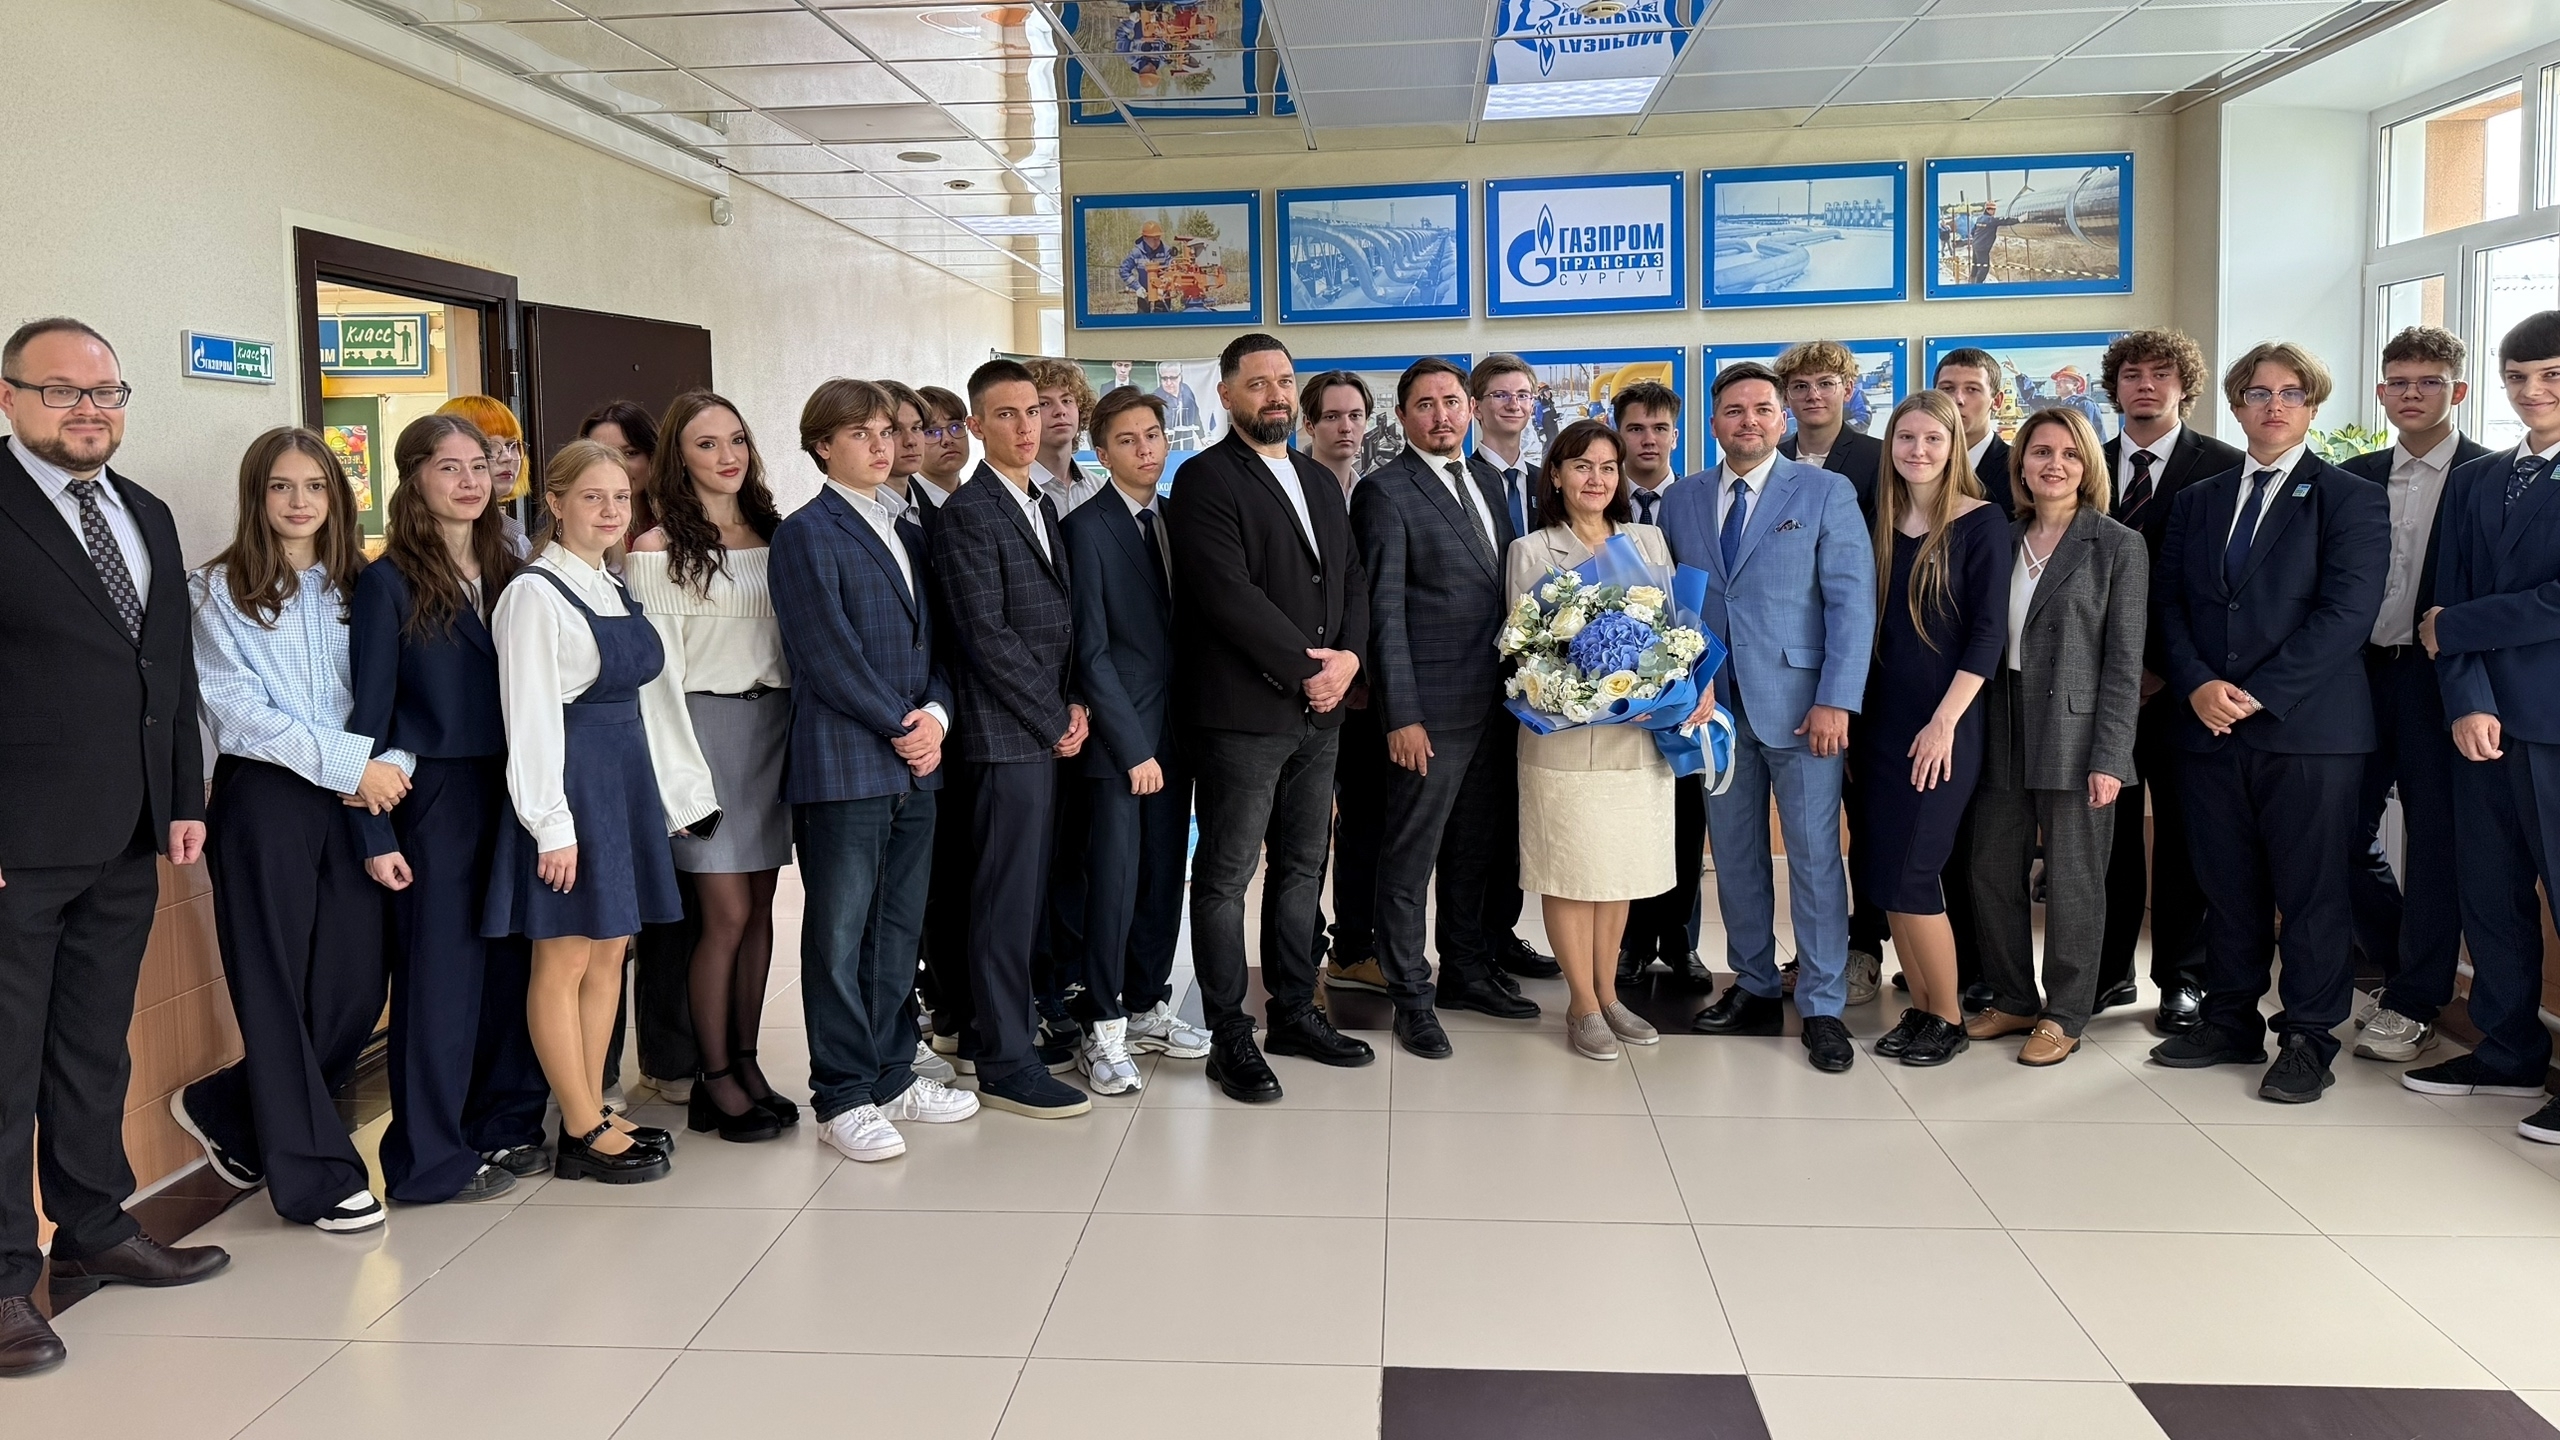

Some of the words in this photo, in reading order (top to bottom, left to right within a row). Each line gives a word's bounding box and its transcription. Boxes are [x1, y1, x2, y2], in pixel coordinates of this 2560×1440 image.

[1559, 223, 1664, 254] ГАЗПРОМ
[1562, 253, 1663, 271] ТРАНСГАЗ
[1559, 270, 1664, 286] СУРГУТ
[346, 326, 392, 343] Класс
[205, 358, 233, 372] ГАЗПРОМ
